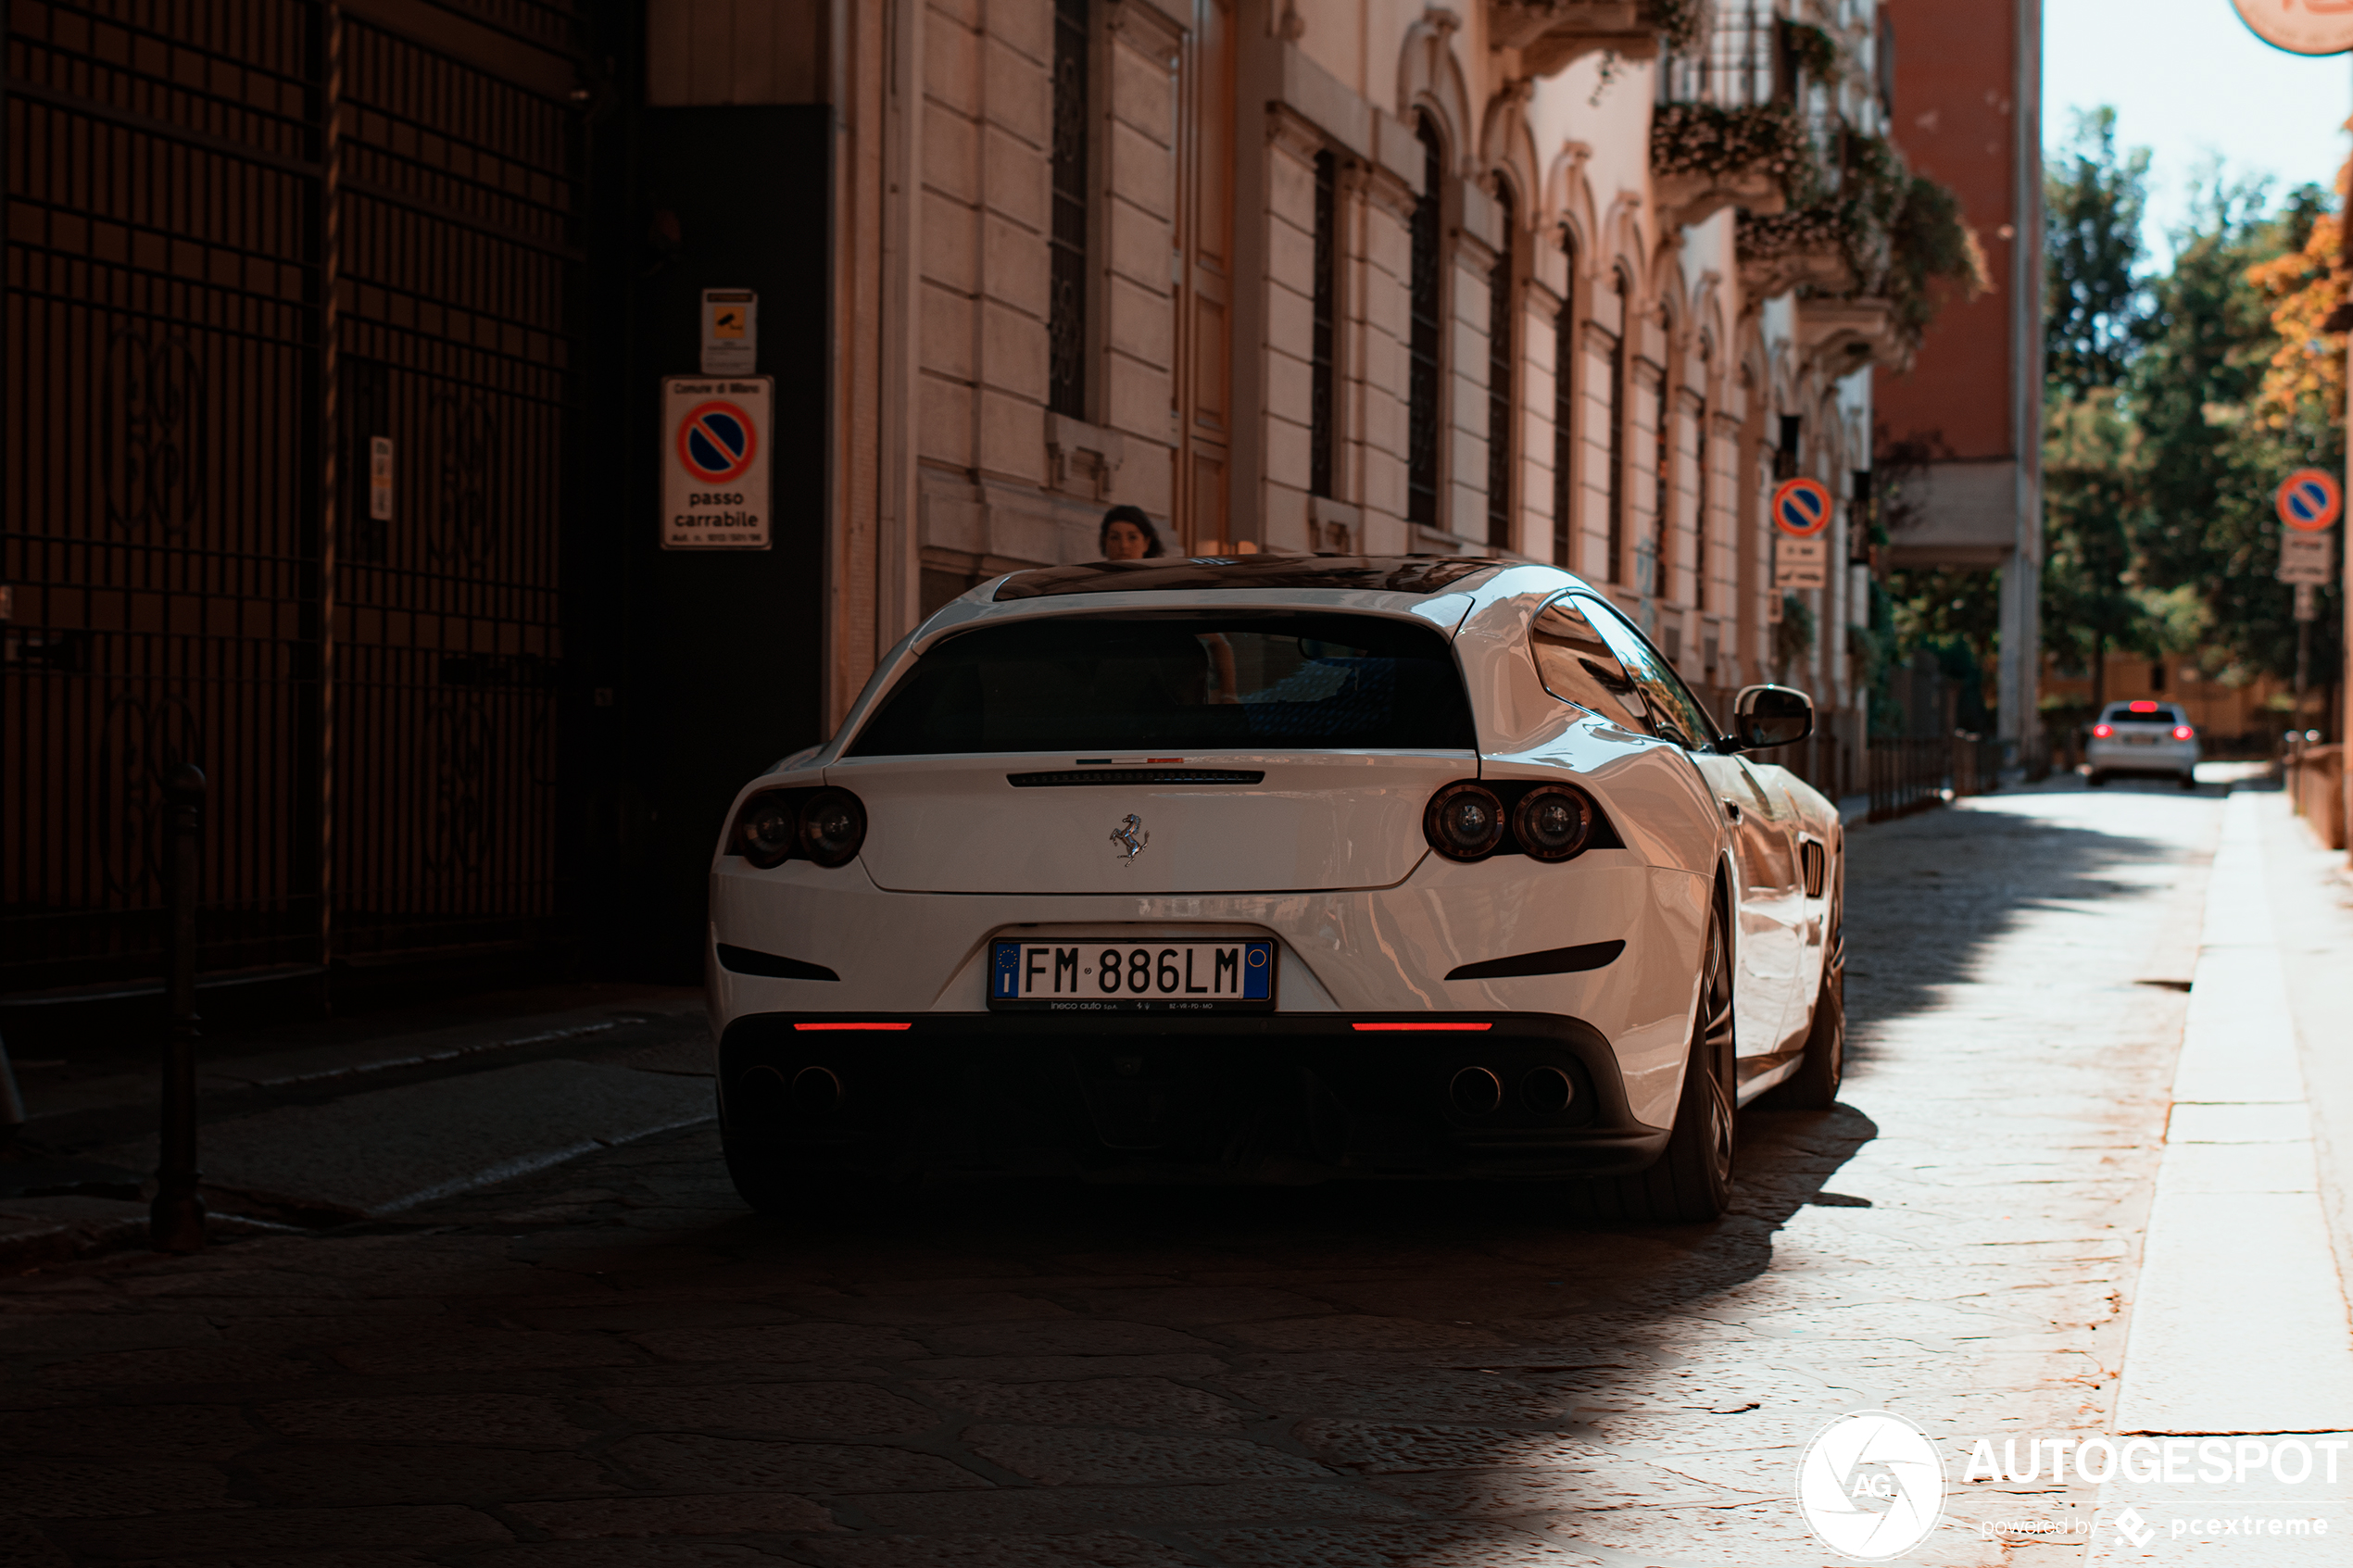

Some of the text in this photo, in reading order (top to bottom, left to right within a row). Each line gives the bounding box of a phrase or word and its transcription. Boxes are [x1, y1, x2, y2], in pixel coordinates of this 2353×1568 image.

[689, 493, 744, 508] passo
[674, 511, 759, 527] carrabile
[1051, 1001, 1077, 1010] ineco
[1079, 1001, 1102, 1010] auto
